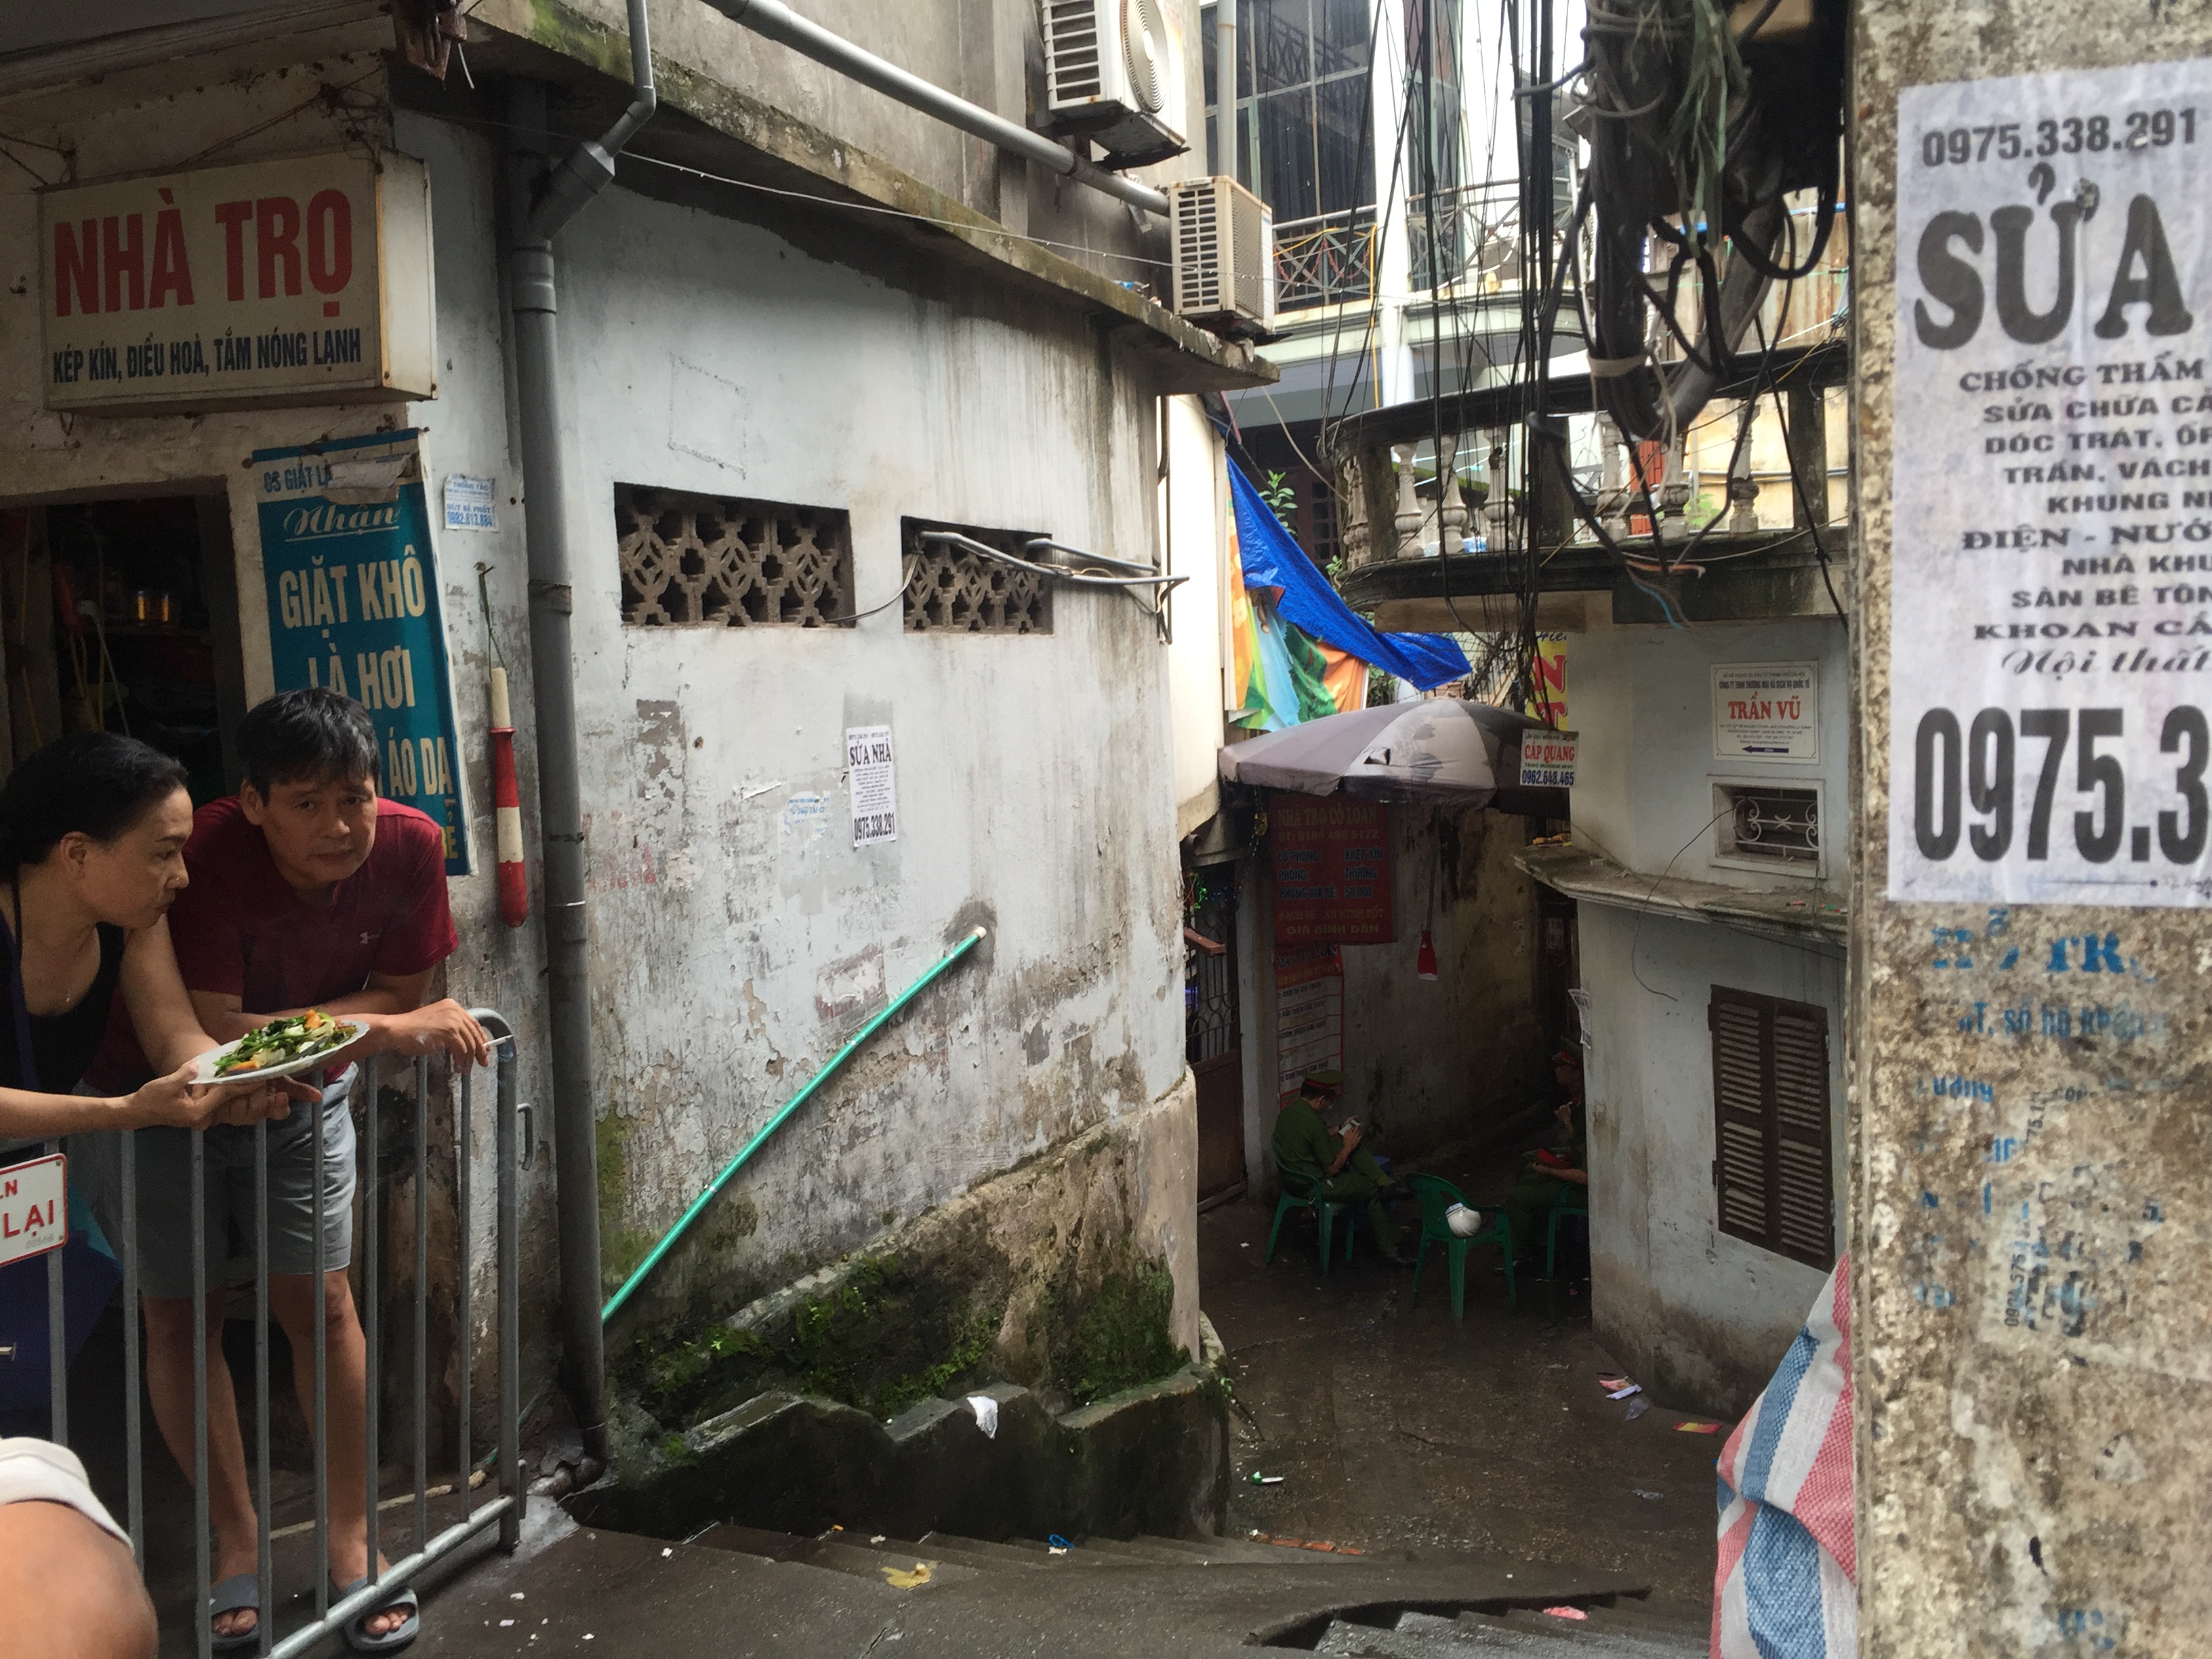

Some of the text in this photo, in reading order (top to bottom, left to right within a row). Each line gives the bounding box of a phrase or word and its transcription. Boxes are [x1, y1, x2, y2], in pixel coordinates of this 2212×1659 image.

[1922, 107, 2198, 167] 0975.338.291
[54, 187, 352, 317] NHÀ TRỌ
[1914, 161, 2193, 350] SỬA
[53, 344, 83, 383] KÉP
[127, 331, 165, 378] ĐIỀU
[214, 326, 251, 371] TẮM
[257, 327, 307, 369] NÓNG
[313, 328, 361, 371] LẠNH
[1959, 350, 2204, 392] CHỐNG THẤM
[1984, 396, 2053, 424] SỬA
[2066, 393, 2159, 419] CHỮA
[2047, 490, 2212, 514] KHUNG N
[1962, 524, 2071, 553] ĐIỆN
[279, 544, 426, 638] GIẶT KHÔ
[1974, 621, 2138, 640] KHOAN
[357, 645, 415, 710] HƠI
[2001, 649, 2098, 681] Nội
[1776, 695, 1801, 720] VŨ
[388, 726, 417, 796] ÁO
[872, 737, 892, 763] NHÀ
[1524, 741, 1576, 763] CÁP QUANG
[1522, 769, 1574, 785] 0962.648.465
[1915, 705, 2209, 865] 0975.3
[3, 1199, 54, 1240] LẠI
